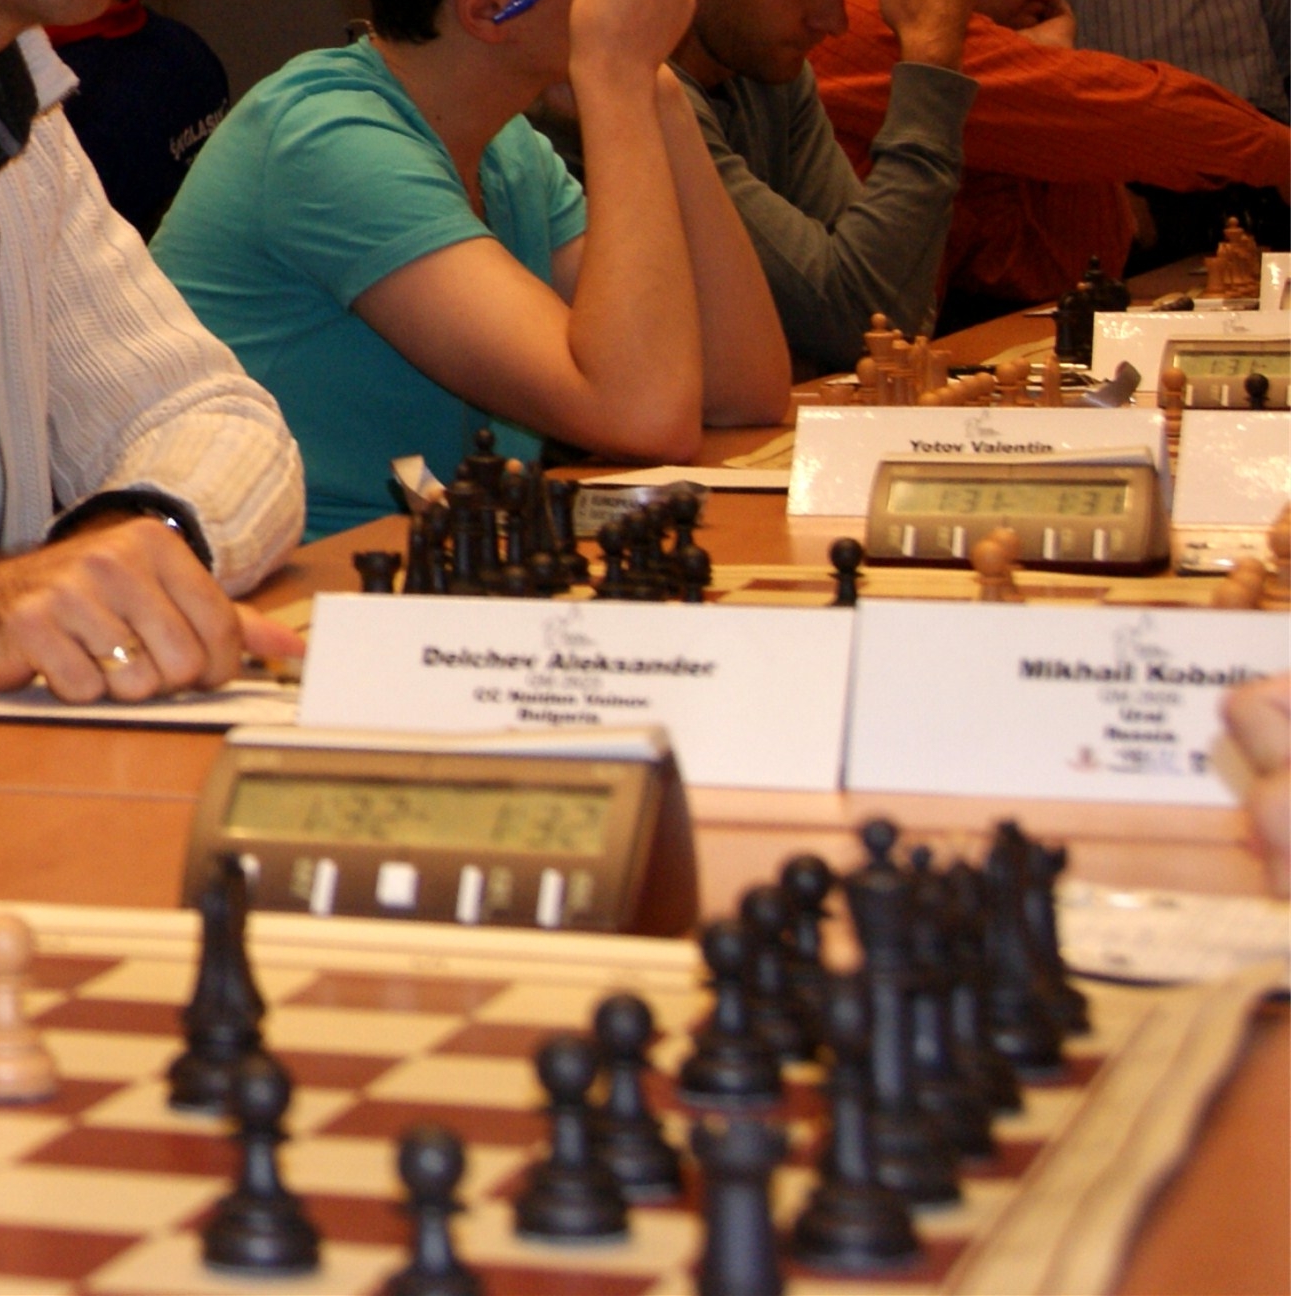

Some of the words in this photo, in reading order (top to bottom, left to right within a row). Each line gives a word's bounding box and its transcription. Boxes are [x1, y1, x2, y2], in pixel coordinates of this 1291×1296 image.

[908, 439, 963, 454] Yotov
[970, 440, 1054, 455] Valentin
[549, 652, 716, 675] Aleksander
[1020, 659, 1135, 682] Mikhail
